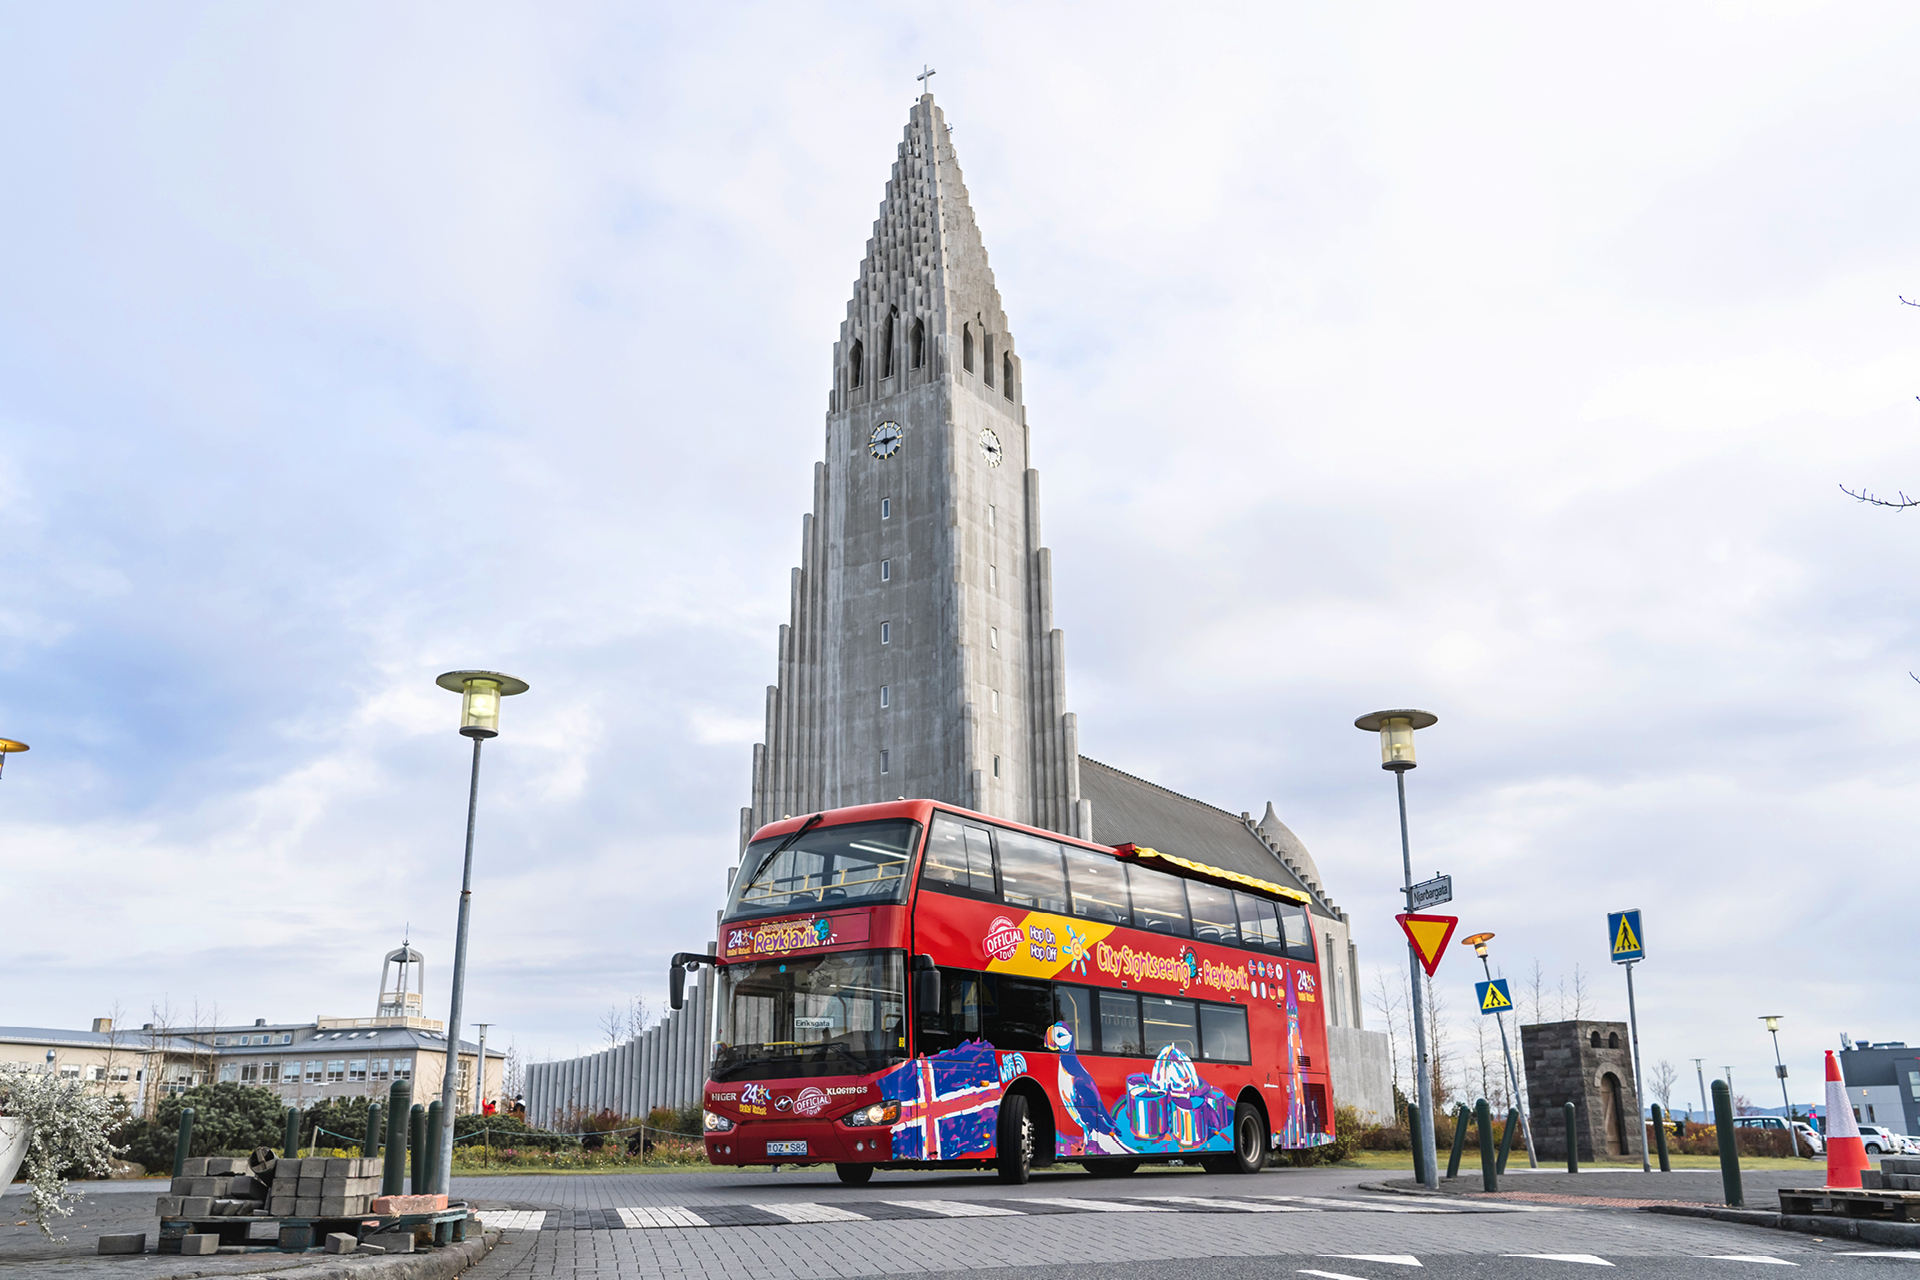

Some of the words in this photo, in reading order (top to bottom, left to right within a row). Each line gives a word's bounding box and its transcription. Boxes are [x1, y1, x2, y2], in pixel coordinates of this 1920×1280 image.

[754, 924, 819, 955] Reykjavik
[986, 930, 1023, 953] OFFICIAL
[1029, 924, 1045, 944] Hop
[1045, 927, 1056, 944] On
[999, 946, 1016, 960] TOUR
[1030, 943, 1045, 962] Hop
[1045, 945, 1058, 962] Off
[1203, 959, 1249, 992] Reykjavik
[711, 1093, 737, 1101] HIGER
[741, 1083, 757, 1103] 24
[796, 1096, 829, 1111] OFFICIAL
[806, 1105, 822, 1116] TOUR
[772, 1143, 784, 1153] OZ
[790, 1142, 806, 1152] S82
